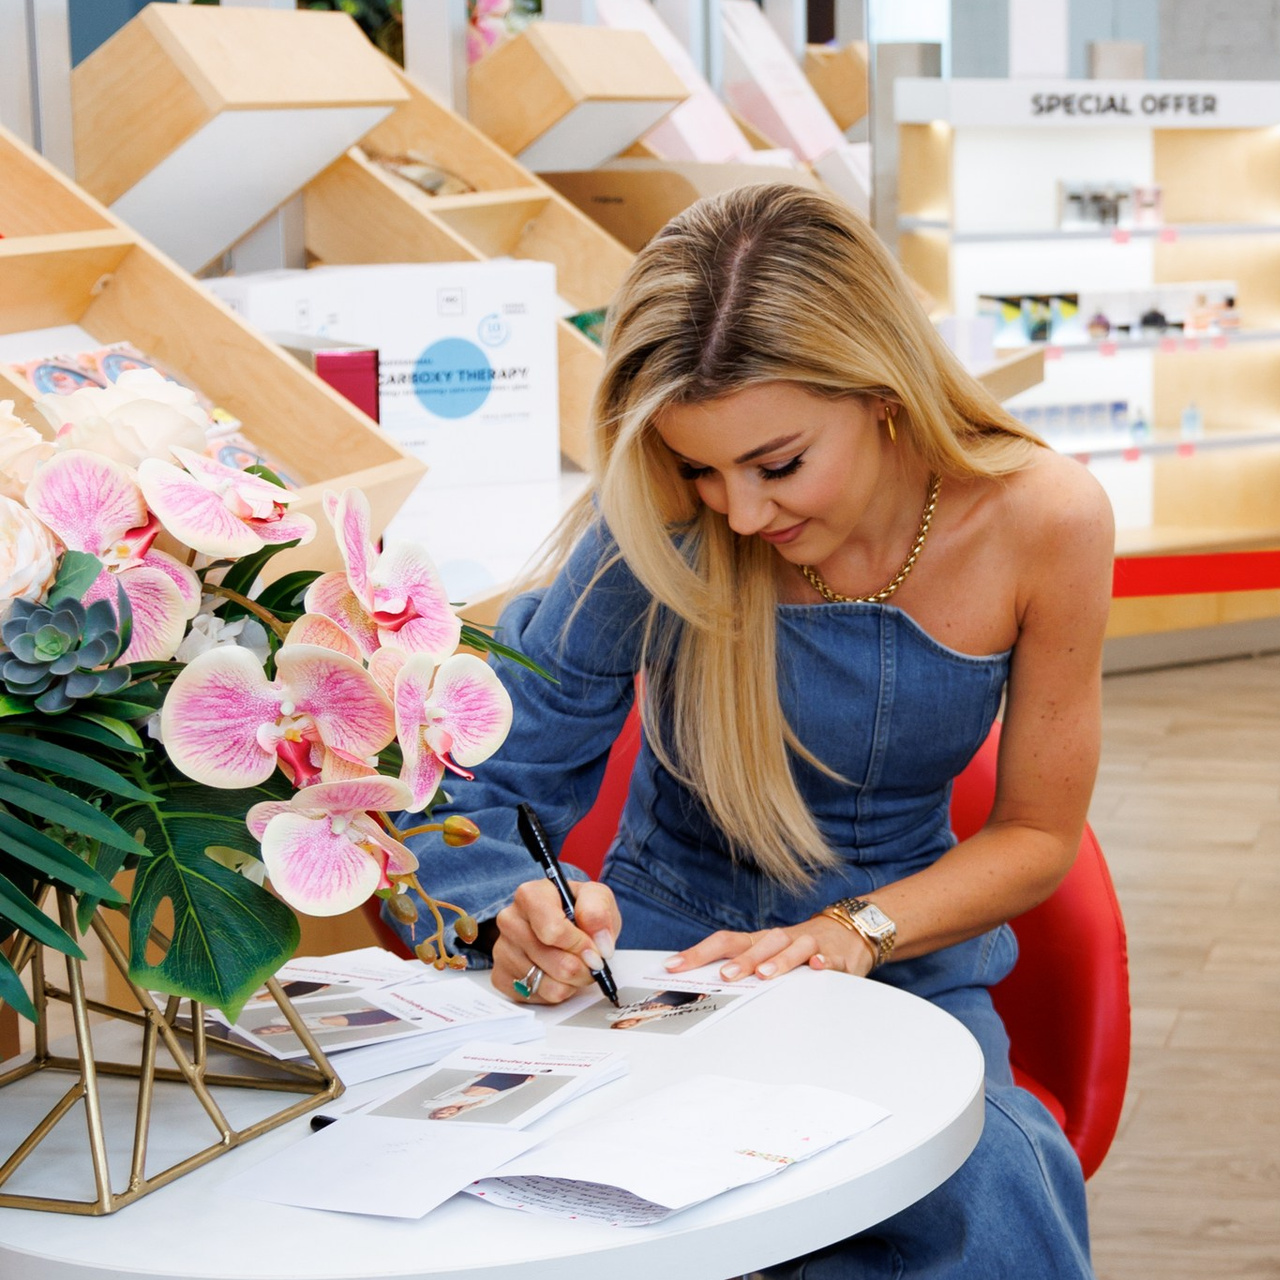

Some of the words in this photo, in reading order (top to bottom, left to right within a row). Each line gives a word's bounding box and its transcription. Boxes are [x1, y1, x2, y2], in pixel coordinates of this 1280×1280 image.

[1031, 92, 1133, 116] SPECIAL
[1140, 92, 1217, 116] OFFER
[458, 366, 529, 383] THERAPY
